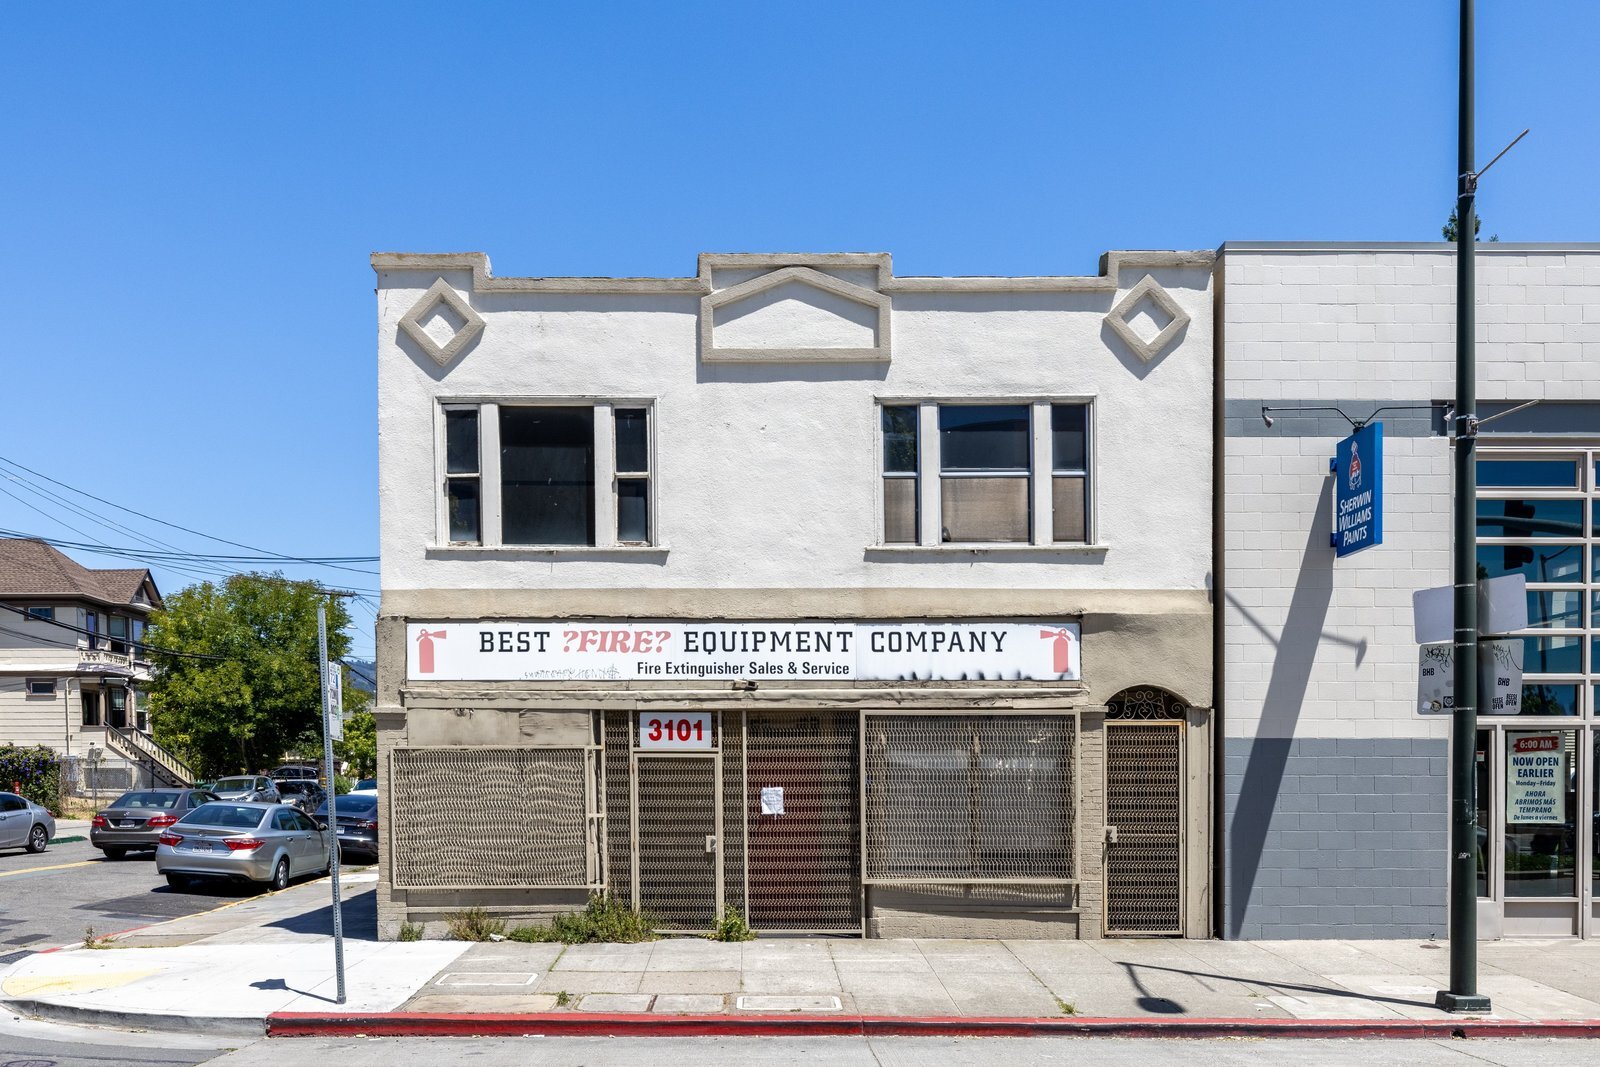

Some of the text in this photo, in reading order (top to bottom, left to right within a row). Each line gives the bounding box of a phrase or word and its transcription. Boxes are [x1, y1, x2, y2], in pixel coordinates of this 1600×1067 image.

[1340, 489, 1372, 516] SHERWIN
[1339, 506, 1372, 532] WILLIAMS
[1343, 525, 1368, 547] PAINTS
[479, 629, 1008, 655] BEST ?FIRE? EQUIPMENT COMPANY
[637, 661, 662, 675] Fire
[665, 661, 745, 678] Extinguisher
[749, 661, 784, 675] Sales
[787, 661, 798, 675] &
[802, 661, 850, 675] Service
[1422, 667, 1435, 677] BHB
[648, 718, 703, 742] 3101
[1519, 739, 1553, 749] 6:00 AM
[1512, 757, 1559, 767] NOW OPEN
[1517, 768, 1554, 778] EARLIER
[1543, 797, 1556, 805] MÁS
[1519, 806, 1552, 814] TEMPRANO
